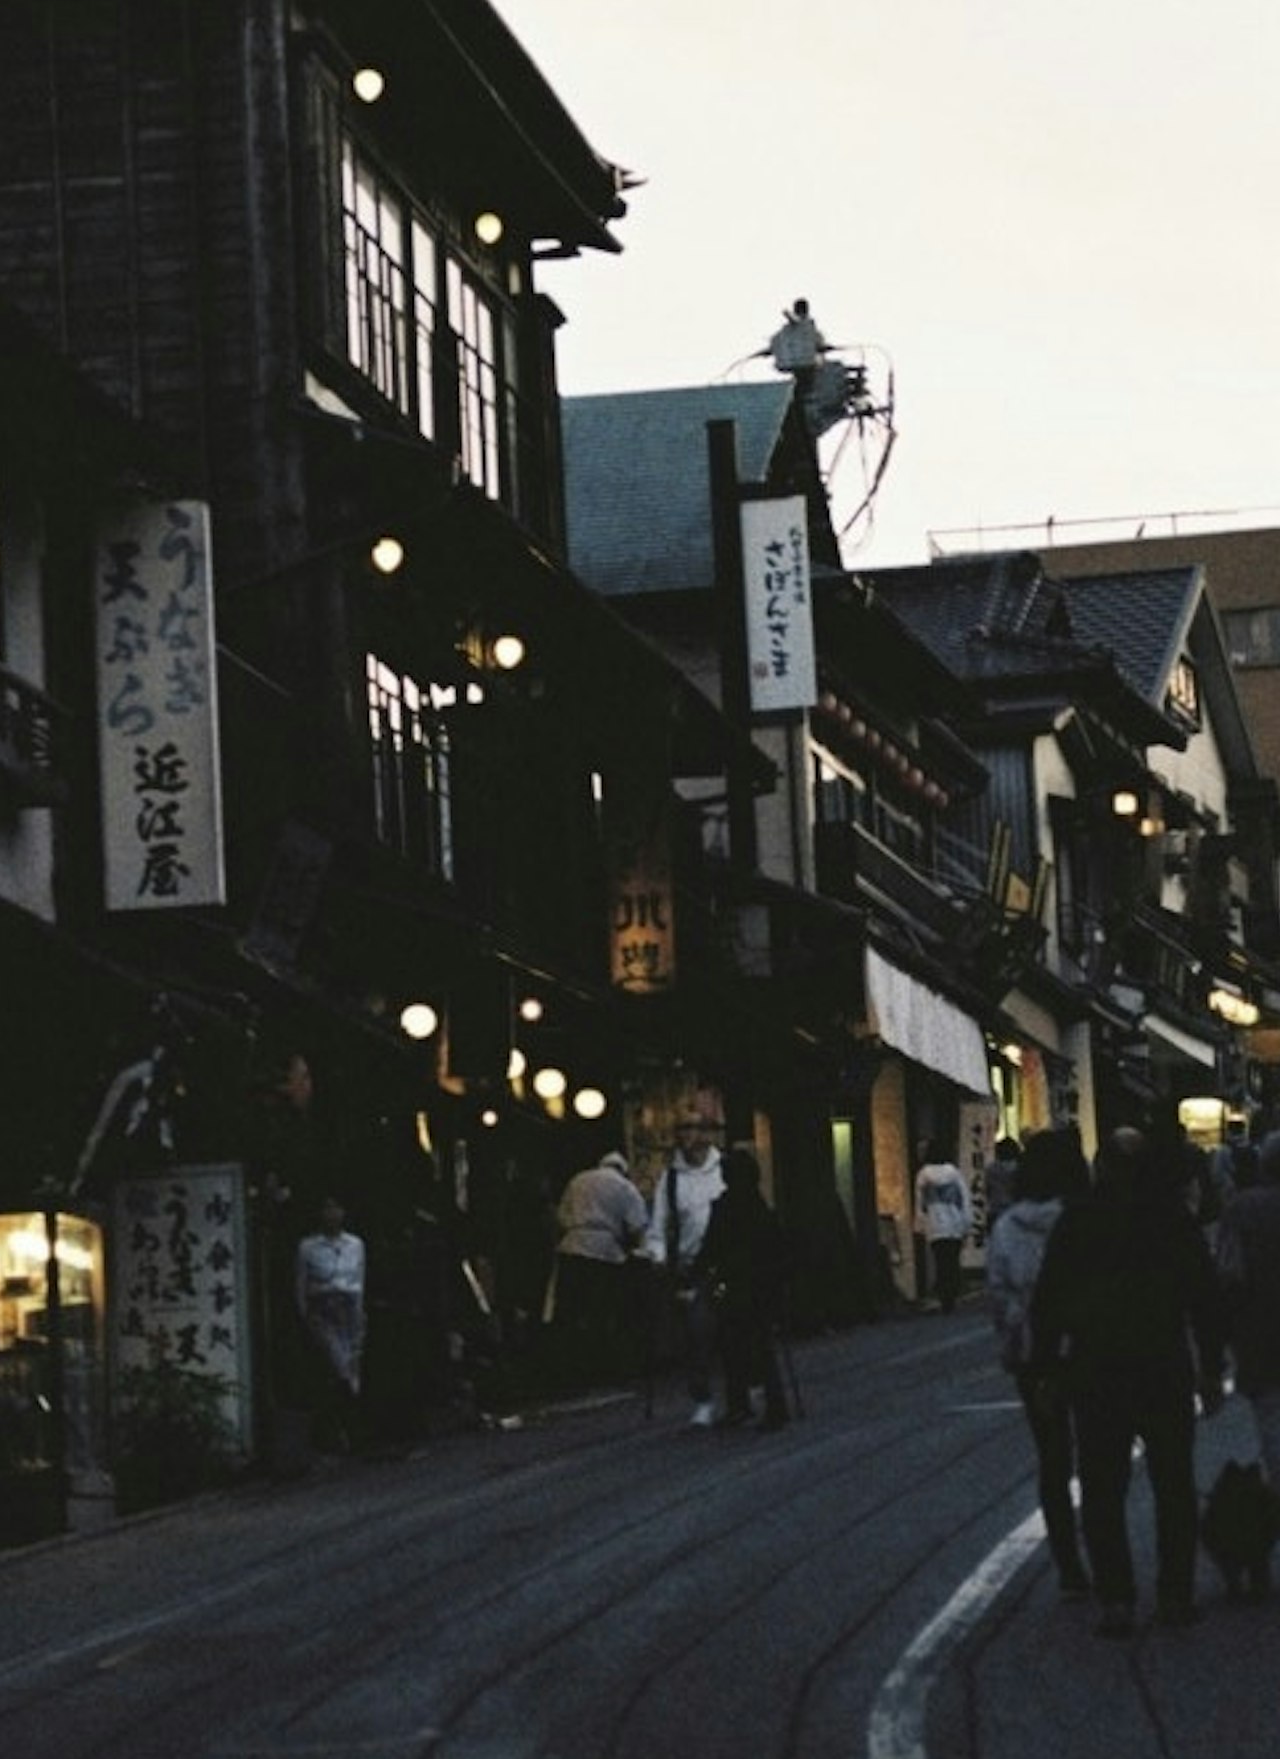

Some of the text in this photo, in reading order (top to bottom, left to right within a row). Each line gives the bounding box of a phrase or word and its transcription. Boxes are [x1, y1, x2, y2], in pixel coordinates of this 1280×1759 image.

[102, 540, 158, 738] 天ぷら
[156, 505, 206, 716] うなぎ
[133, 746, 192, 898] 近江屋
